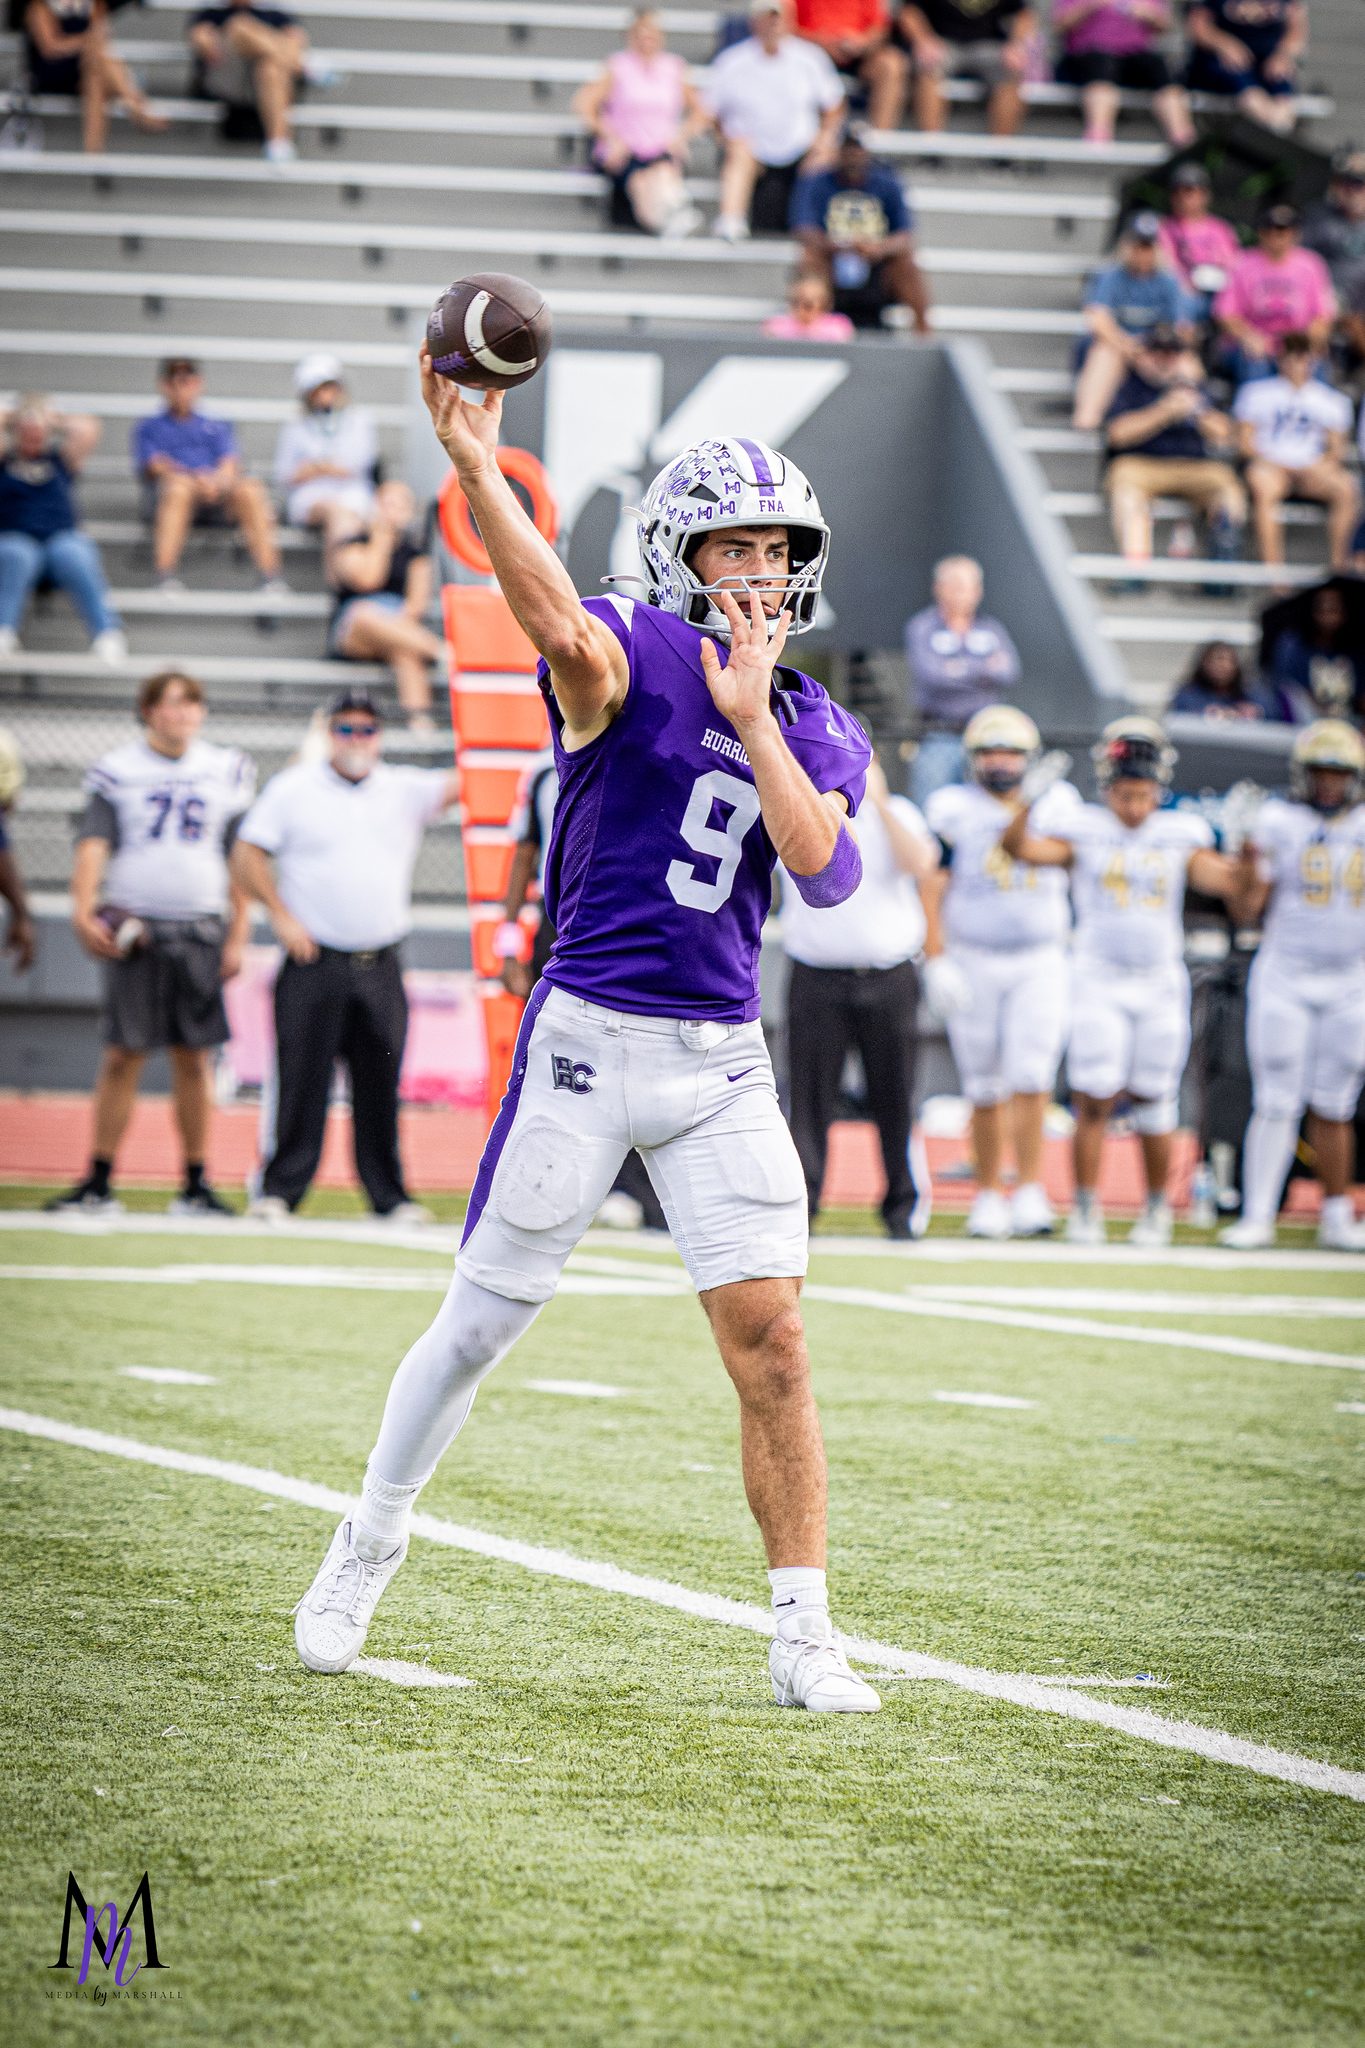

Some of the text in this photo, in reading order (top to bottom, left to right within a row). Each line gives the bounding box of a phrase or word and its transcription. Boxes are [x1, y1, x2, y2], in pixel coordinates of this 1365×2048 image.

[759, 500, 785, 513] FNA
[146, 791, 205, 841] 76
[665, 769, 761, 914] 9
[985, 846, 1038, 890] 4
[1100, 852, 1168, 910] 43
